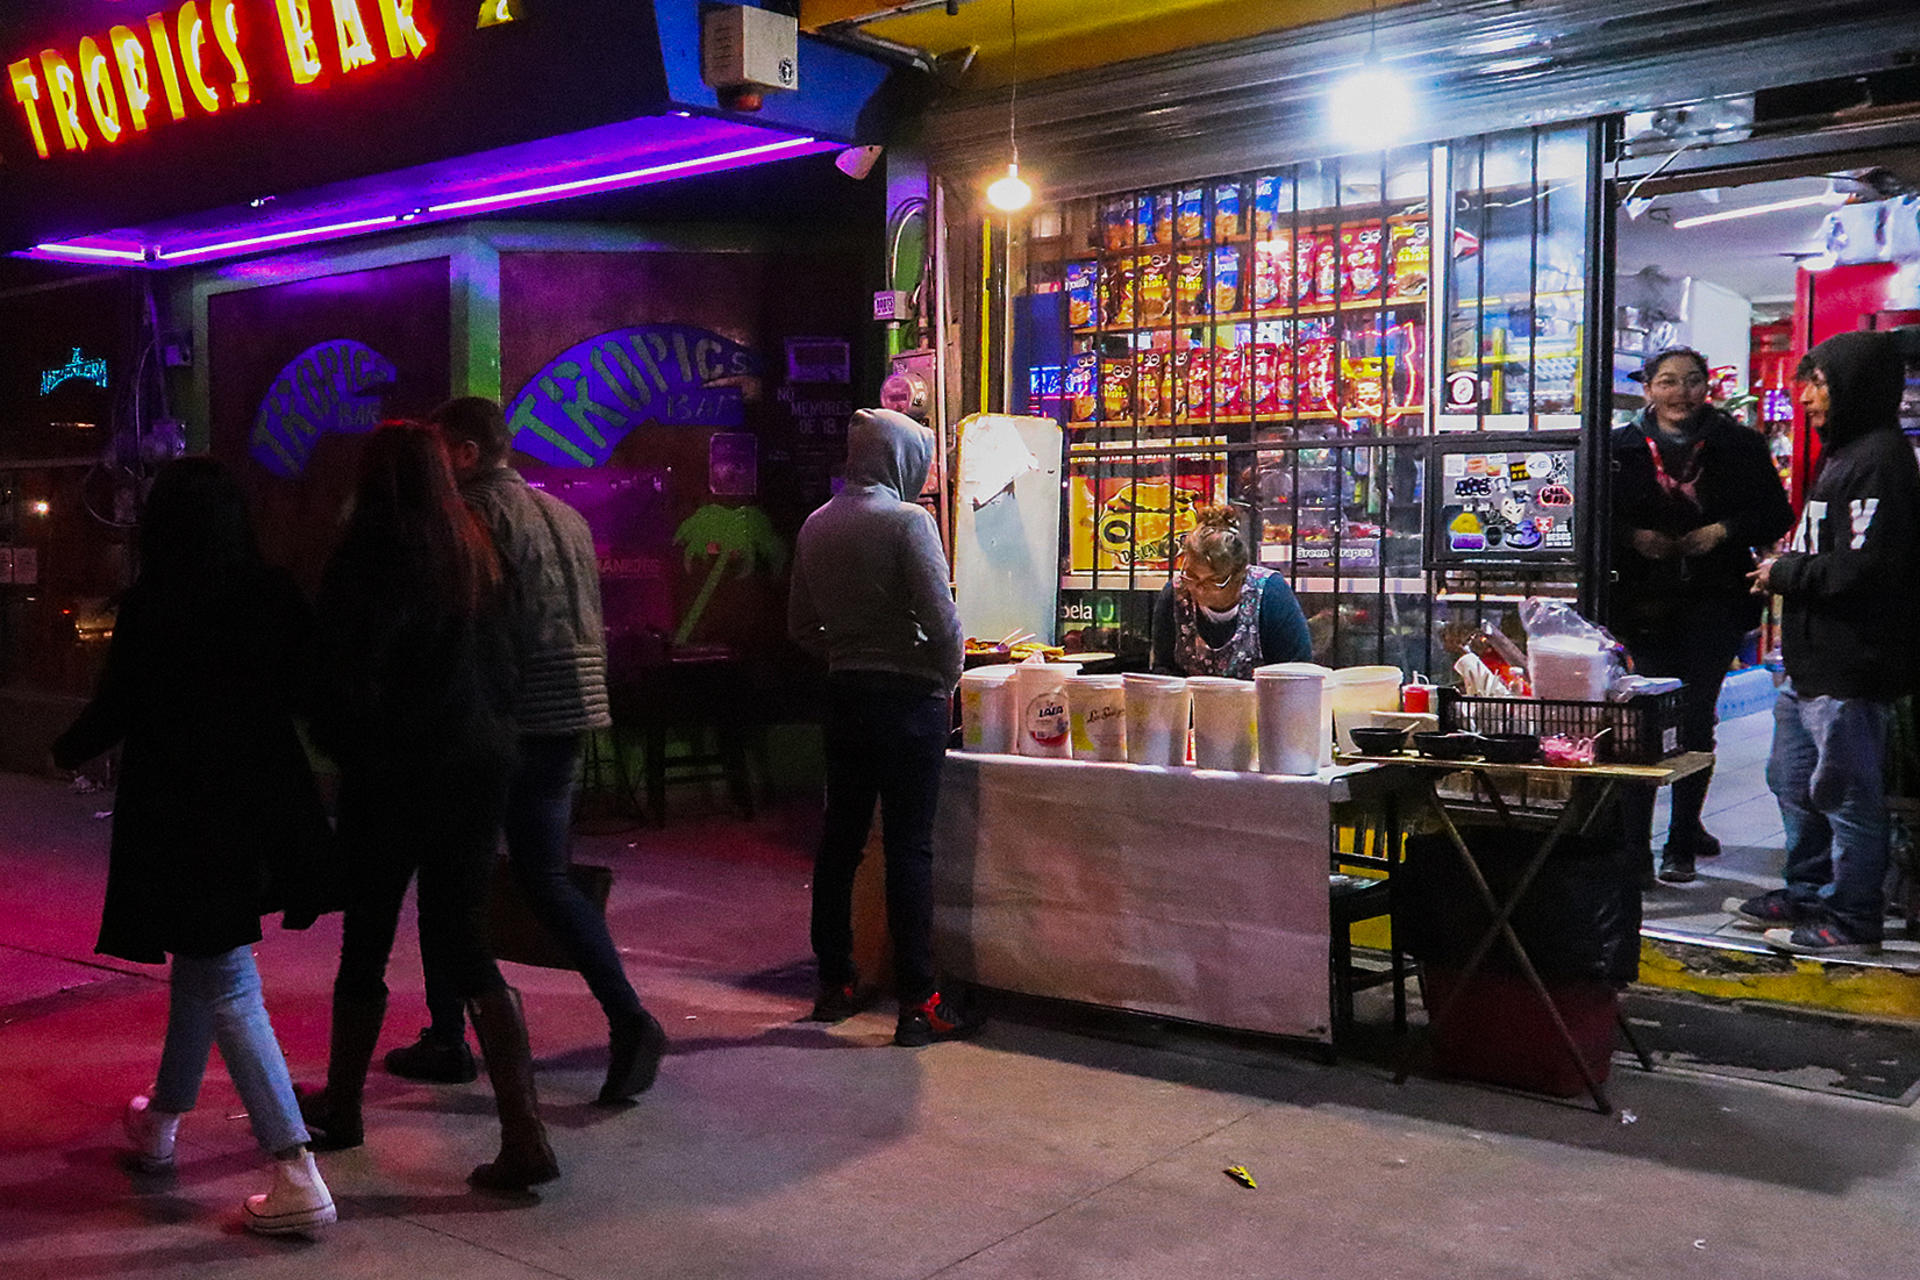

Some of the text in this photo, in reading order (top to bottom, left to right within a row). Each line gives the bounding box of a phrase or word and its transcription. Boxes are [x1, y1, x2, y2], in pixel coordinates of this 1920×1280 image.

[8, 0, 427, 159] TROPICS BAR
[506, 328, 748, 468] TROPICS
[1296, 546, 1329, 558] Green
[1039, 705, 1064, 718] LALA
